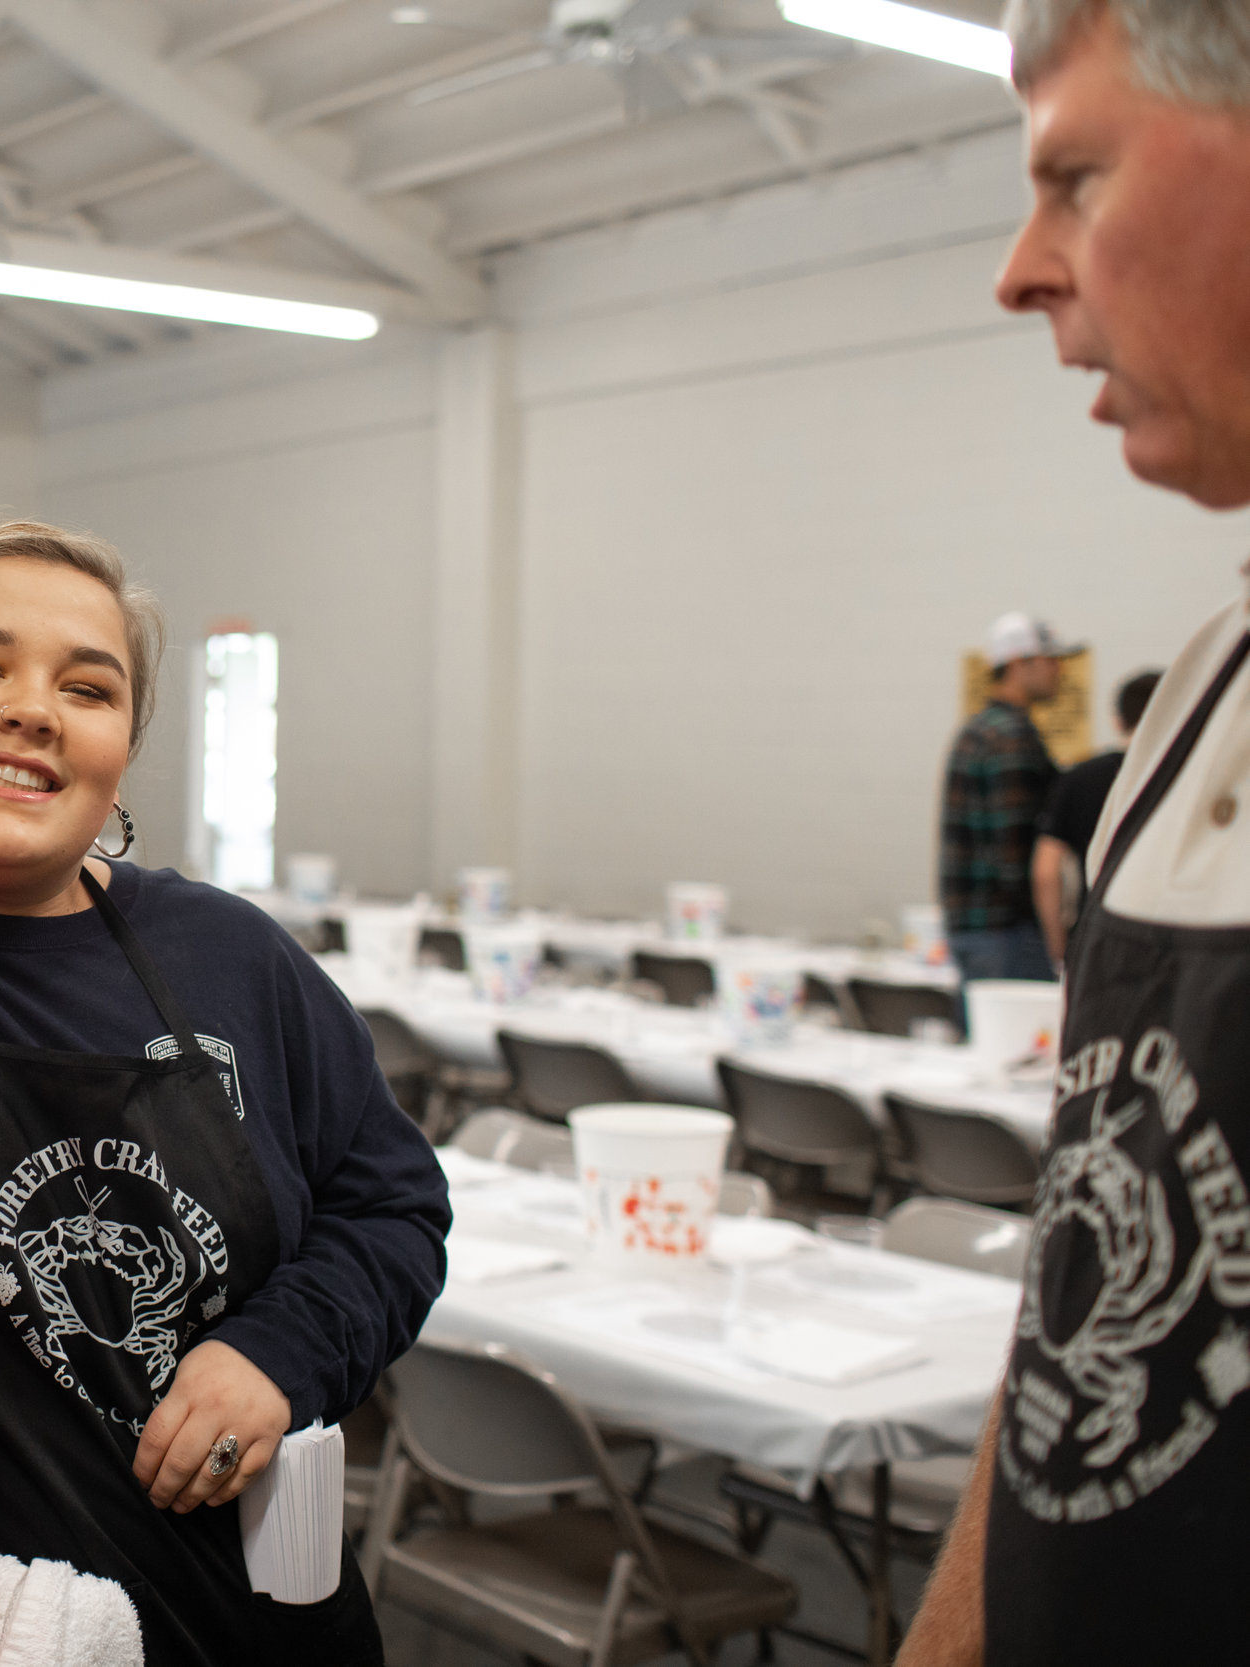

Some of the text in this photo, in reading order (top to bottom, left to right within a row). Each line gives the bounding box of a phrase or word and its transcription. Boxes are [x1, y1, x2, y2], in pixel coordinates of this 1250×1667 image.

[171, 1187, 228, 1275] FEED
[9, 1313, 74, 1389] A Time to
